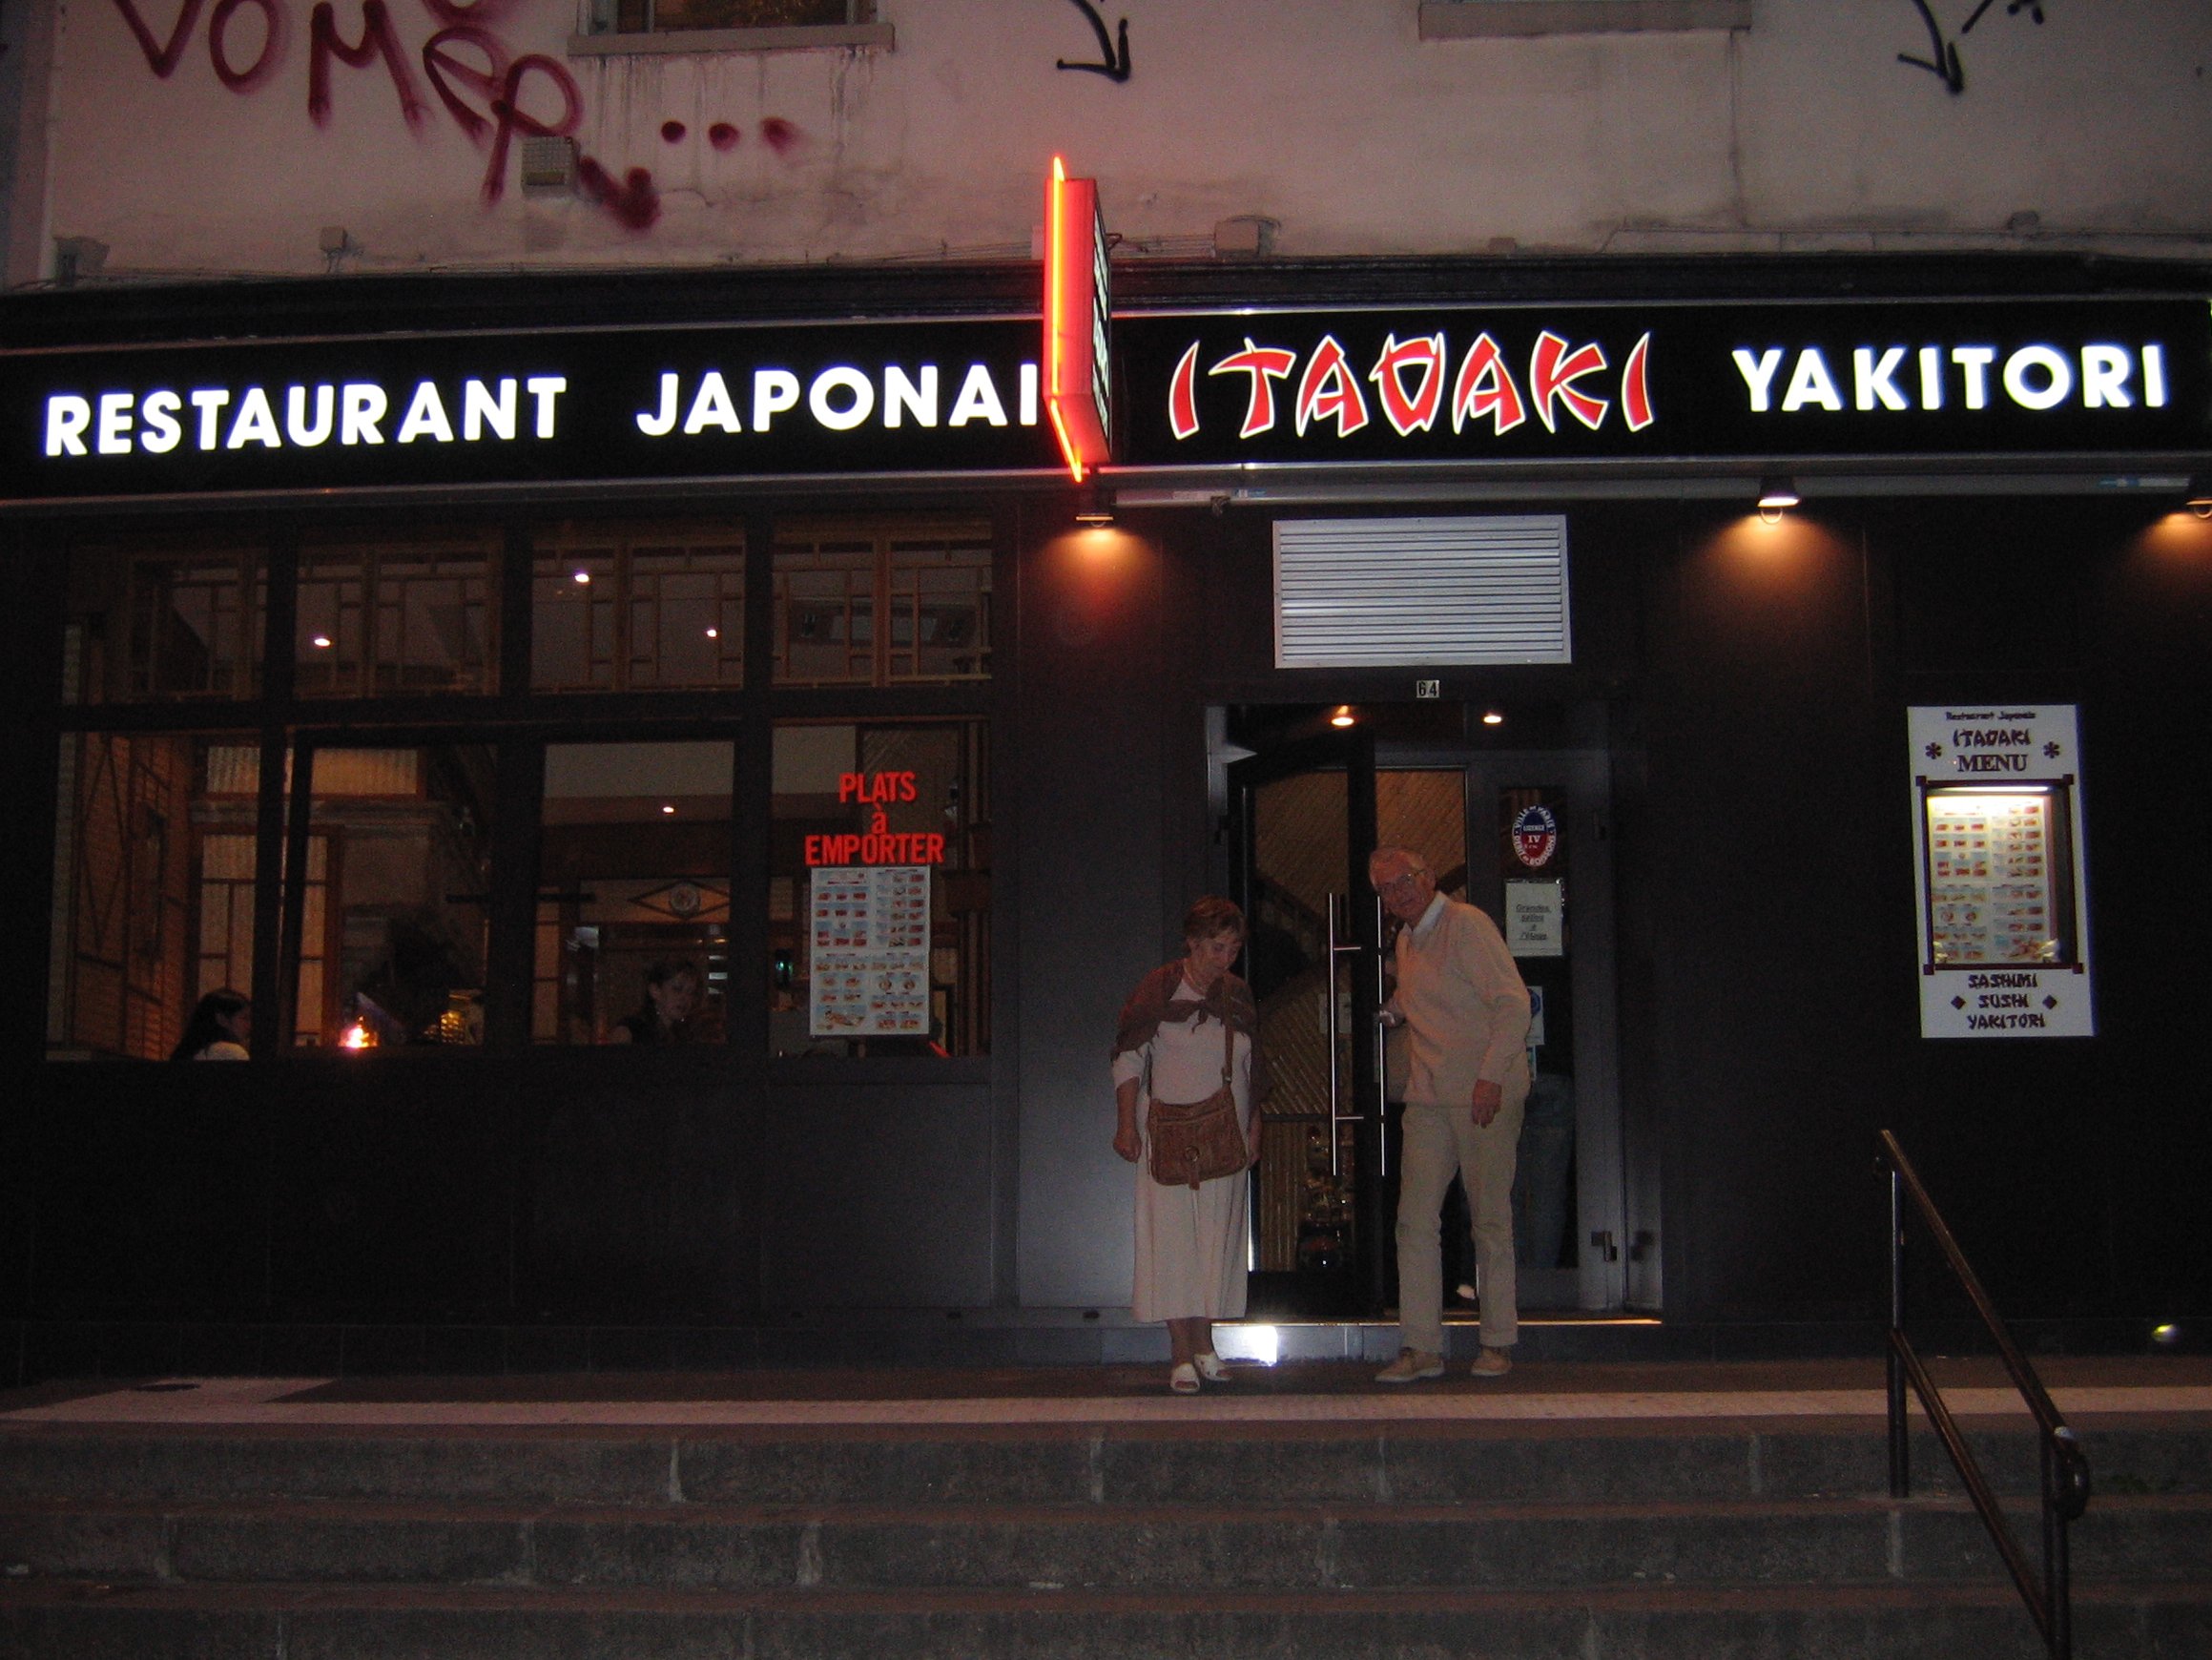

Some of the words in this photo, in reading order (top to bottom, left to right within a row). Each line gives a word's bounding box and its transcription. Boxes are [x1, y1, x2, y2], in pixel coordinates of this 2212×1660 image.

[45, 377, 566, 455] RESTAURANT
[637, 363, 1037, 435] JAPONAI
[1169, 330, 1653, 439] ITADAKI
[1732, 344, 2167, 411] YAKITORI
[1418, 681, 1437, 696] 64
[1953, 729, 2031, 747] ITADAKI
[1957, 755, 2028, 772] MENU
[838, 772, 918, 803] PLATS
[871, 802, 888, 835] à
[1528, 835, 1540, 843] IV
[804, 833, 946, 866] EMPORTER
[1968, 973, 2038, 988] SASHIMI
[1977, 993, 2030, 1008] SUSHI
[1967, 1012, 2046, 1029] YAKITORI
